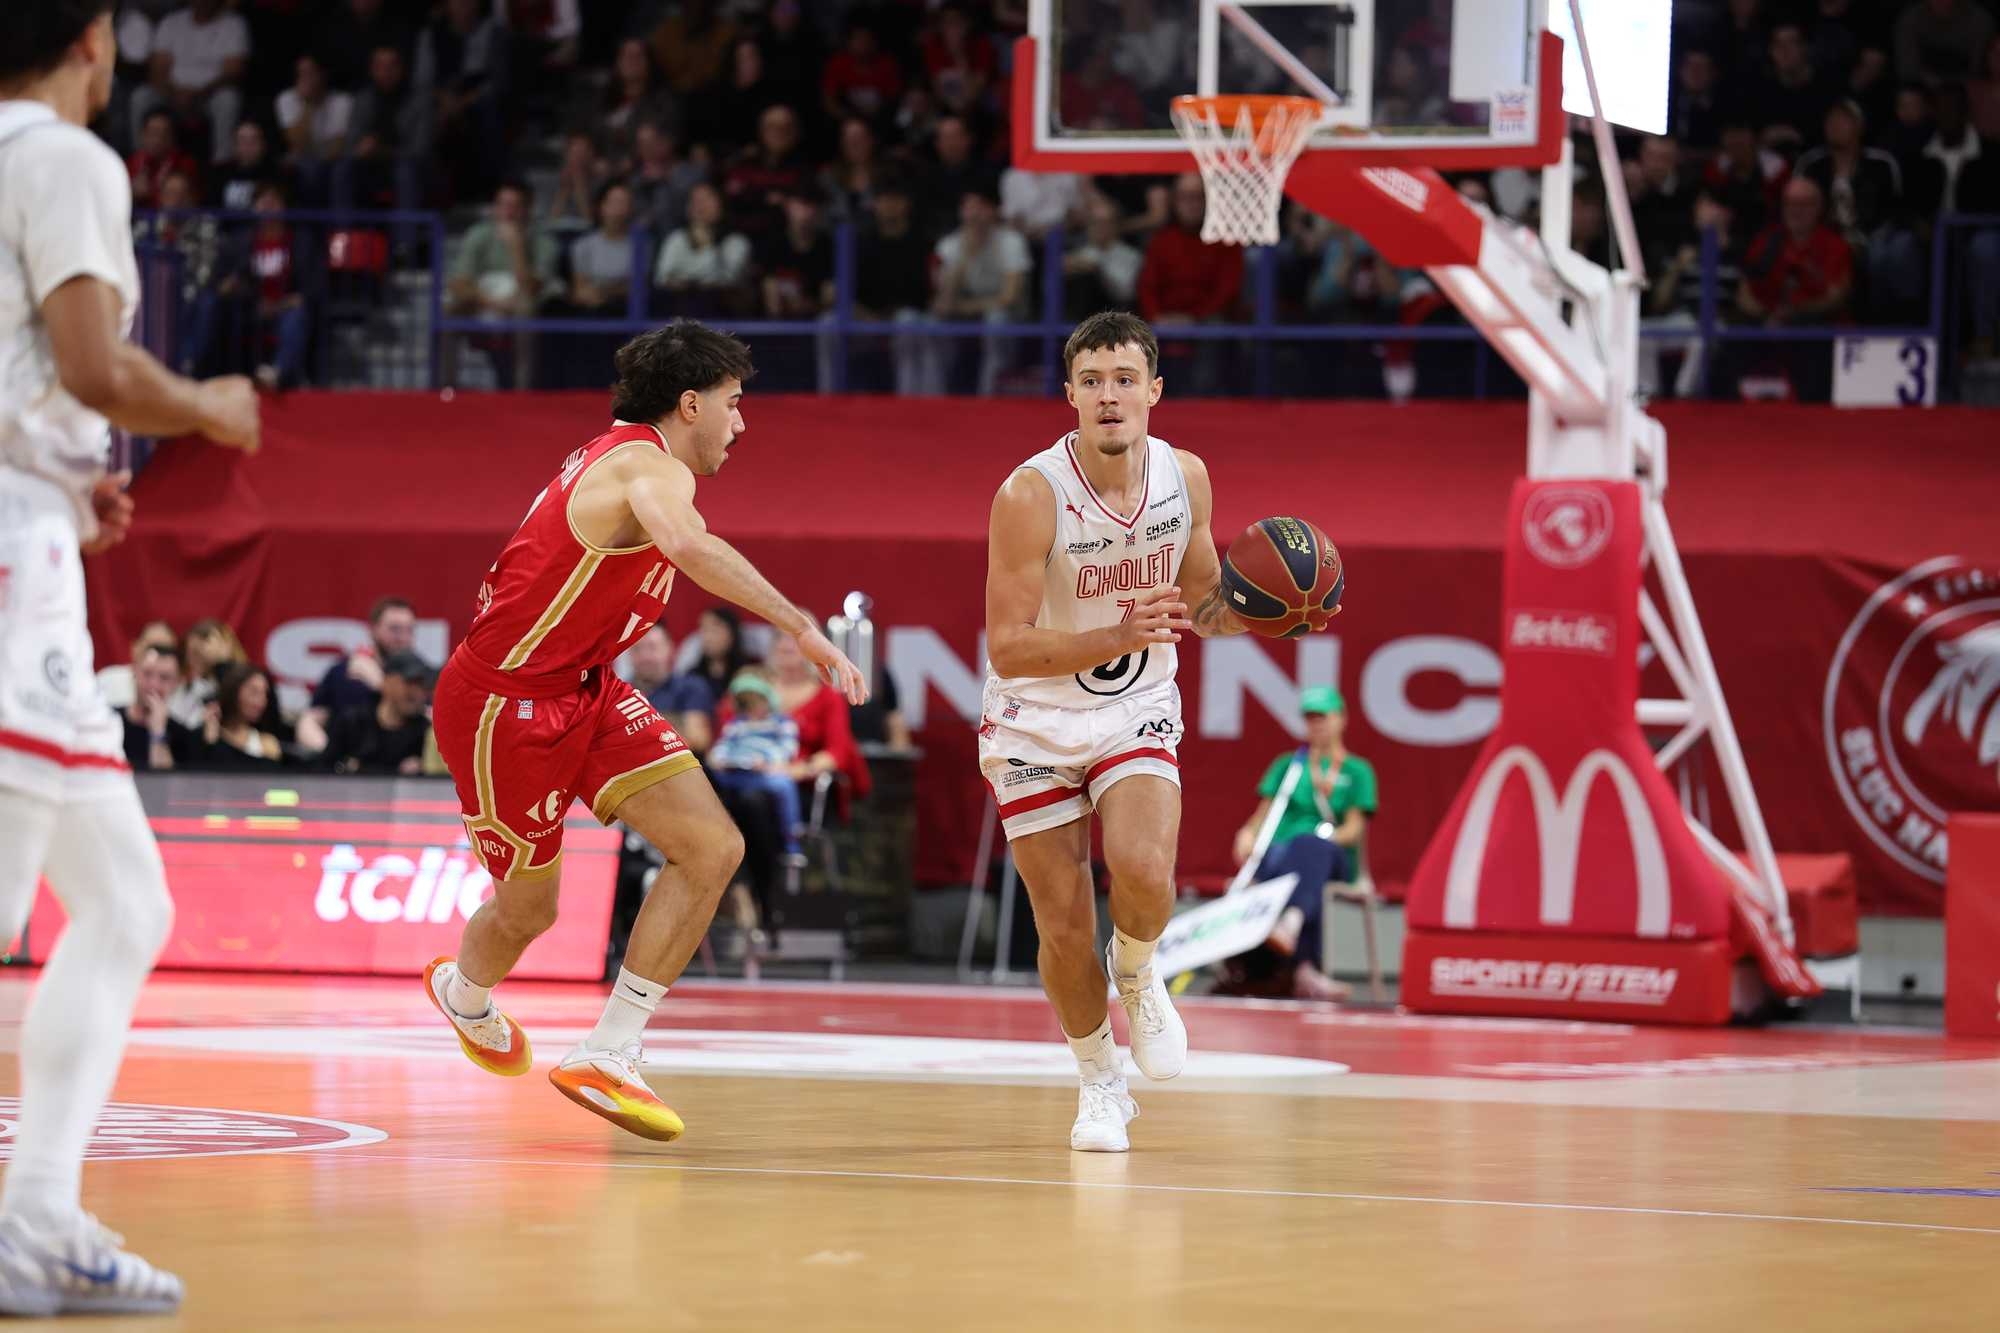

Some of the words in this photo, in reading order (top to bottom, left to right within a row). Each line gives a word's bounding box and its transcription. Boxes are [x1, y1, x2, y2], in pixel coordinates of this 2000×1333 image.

[1897, 336, 1928, 405] 3
[1076, 543, 1174, 599] CHOLET
[1116, 597, 1136, 624] 7
[1511, 612, 1608, 651] Betclic
[625, 712, 665, 736] EIFFA
[481, 839, 506, 858] NCY
